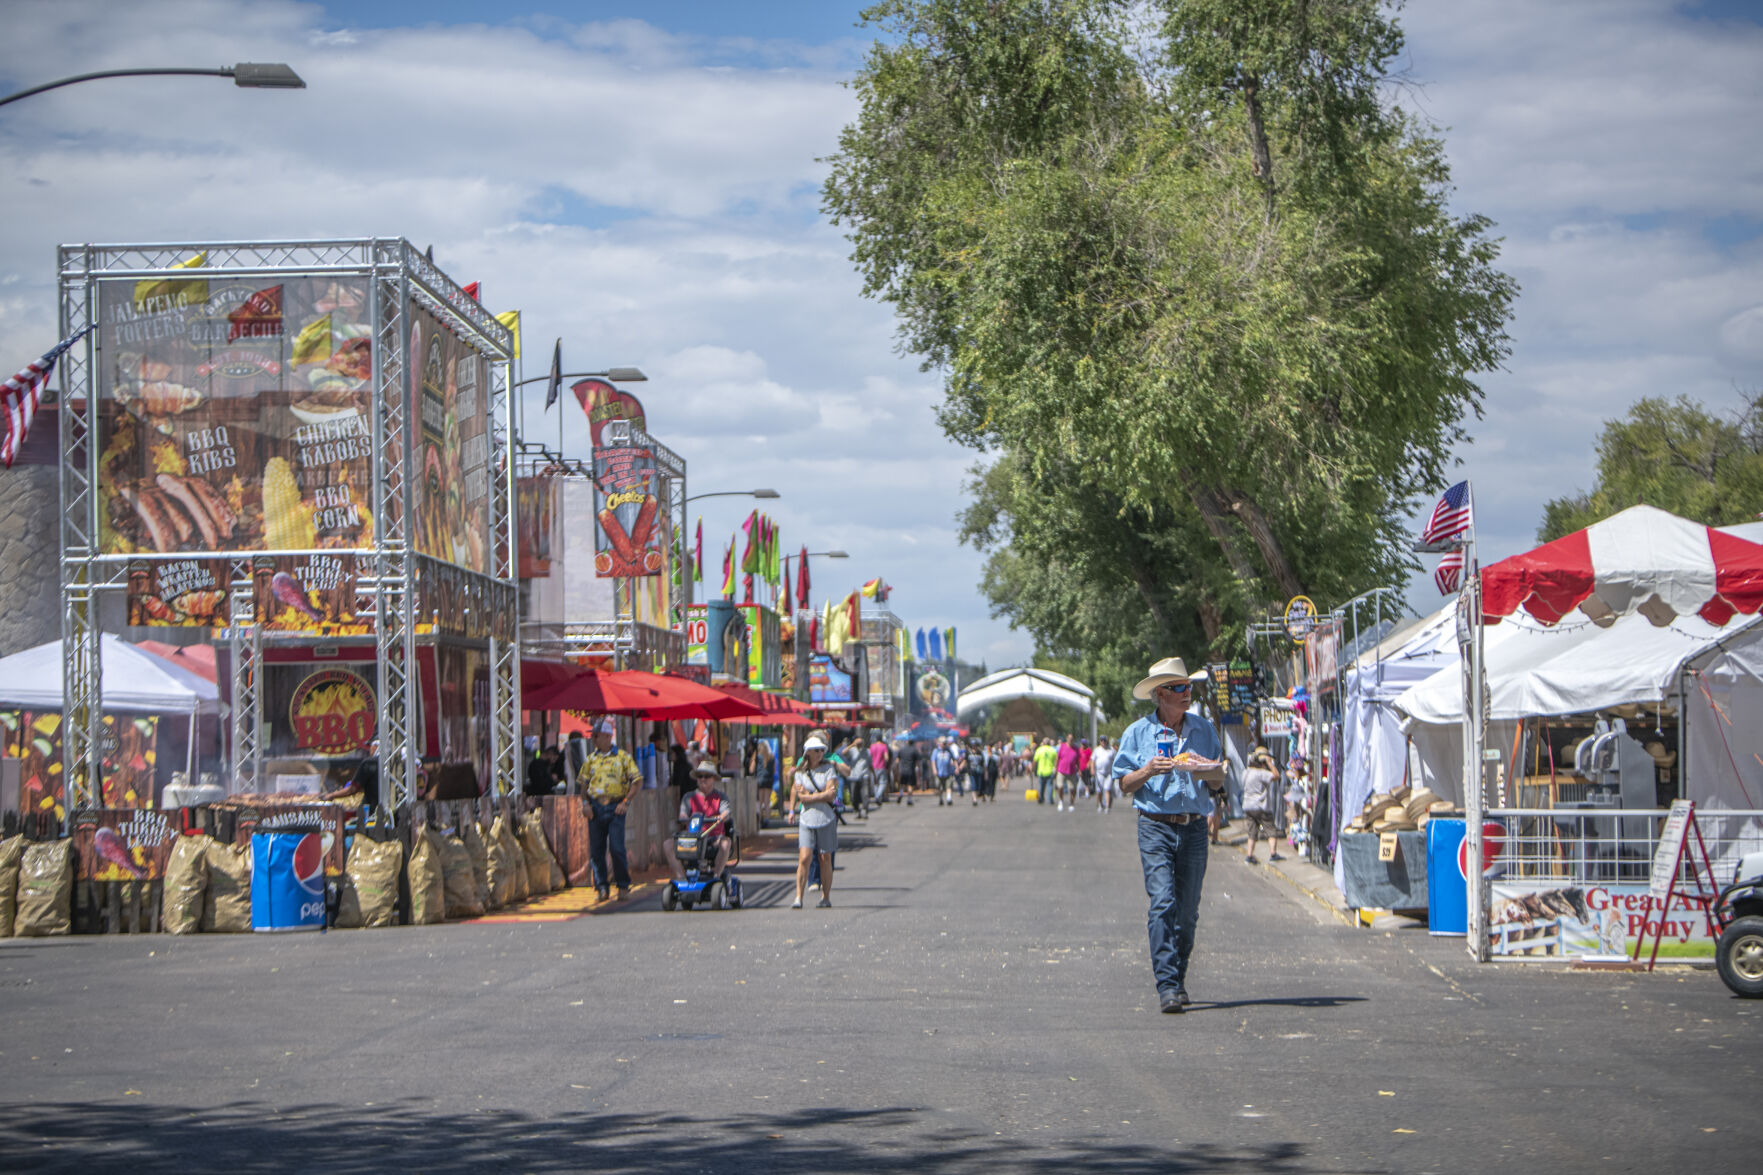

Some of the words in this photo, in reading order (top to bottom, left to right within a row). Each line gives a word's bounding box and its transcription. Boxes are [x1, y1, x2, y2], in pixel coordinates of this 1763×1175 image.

[115, 314, 186, 346] POPPERS
[187, 425, 231, 451] BBQ
[296, 414, 370, 446] CHICKEN
[189, 447, 236, 475] RIBS
[301, 435, 372, 468] KABOBS
[314, 484, 351, 509] BBQ
[606, 490, 645, 510] Cheetos
[313, 504, 360, 531] CORN
[157, 560, 199, 577] BACON
[295, 565, 353, 583] TURKEY
[309, 554, 342, 570] BBQ
[1264, 708, 1295, 723] PHOT
[294, 710, 376, 751] BBQ
[133, 809, 168, 825] BBQ
[118, 820, 179, 840] TURKEY
[1586, 887, 1657, 911] Great
[300, 902, 326, 921] pep
[1626, 914, 1696, 943] Pony
